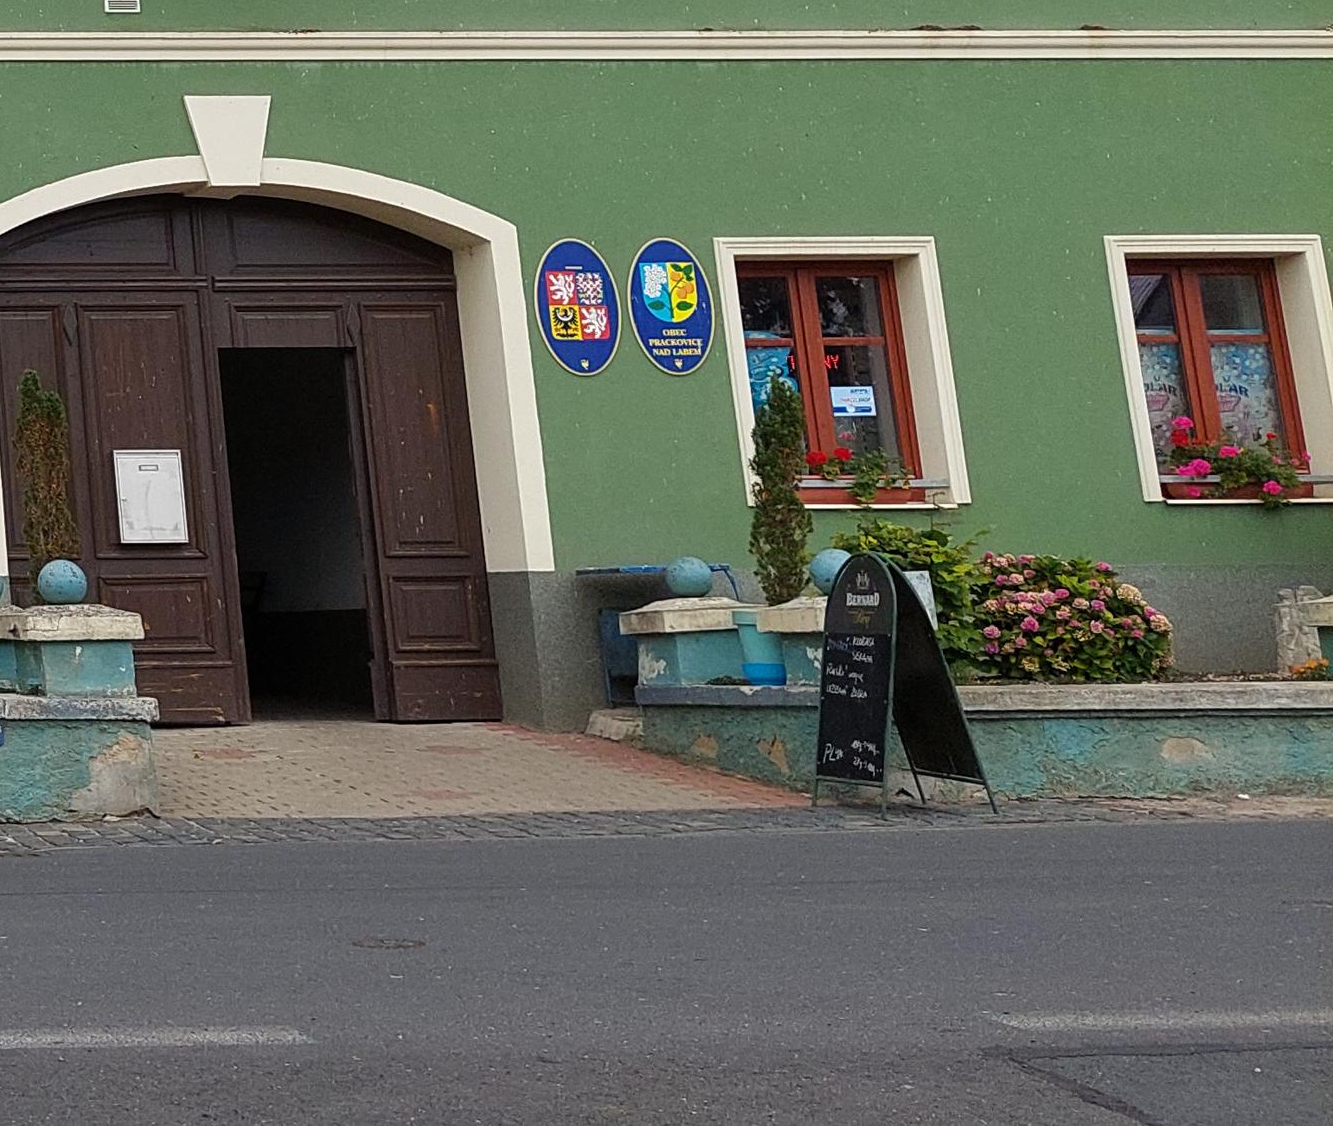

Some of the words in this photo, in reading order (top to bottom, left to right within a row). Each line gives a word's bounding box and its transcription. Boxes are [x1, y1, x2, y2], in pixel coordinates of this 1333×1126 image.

[662, 328, 687, 337] OBEC
[649, 338, 703, 347] PRACKOVICE
[653, 347, 671, 356] NAD
[673, 347, 702, 356] LABEM
[846, 592, 880, 606] BERNARD
